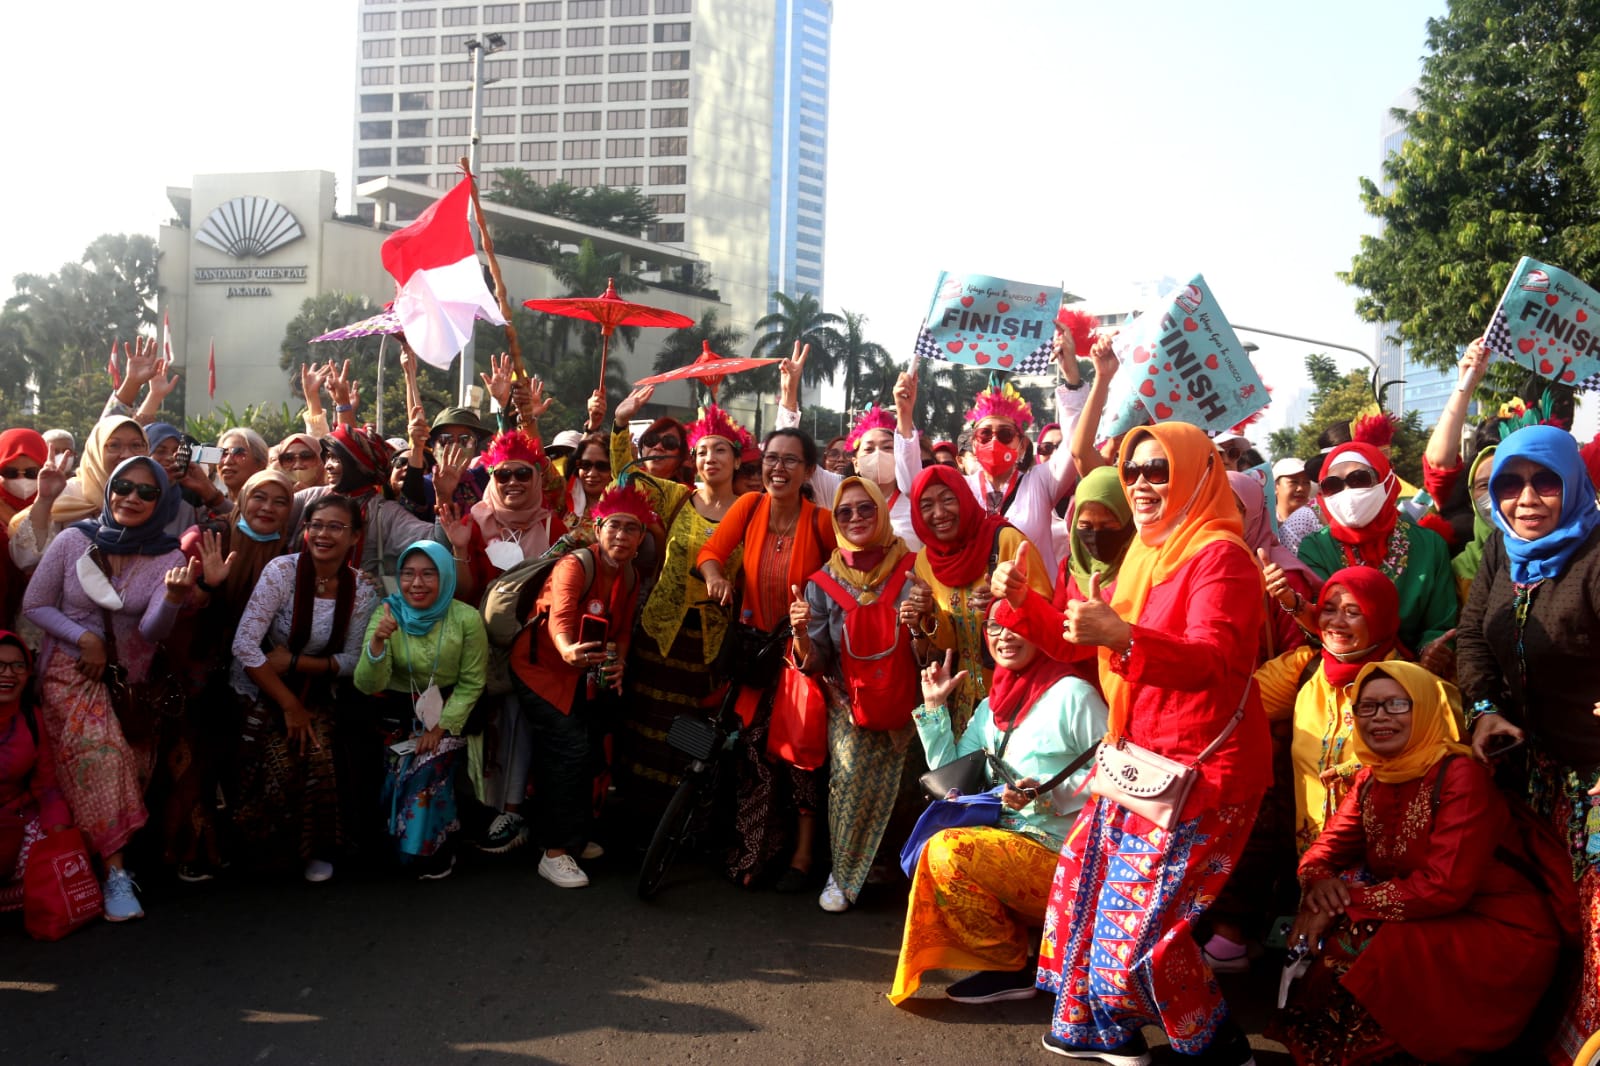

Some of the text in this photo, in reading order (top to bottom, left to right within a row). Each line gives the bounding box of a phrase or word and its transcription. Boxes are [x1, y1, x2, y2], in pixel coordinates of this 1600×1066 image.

[195, 268, 306, 280] MANDARIN ORIENTAL
[226, 287, 272, 298] JAKARTA
[941, 307, 1043, 339] FINISH
[1224, 356, 1242, 382] UNESCO
